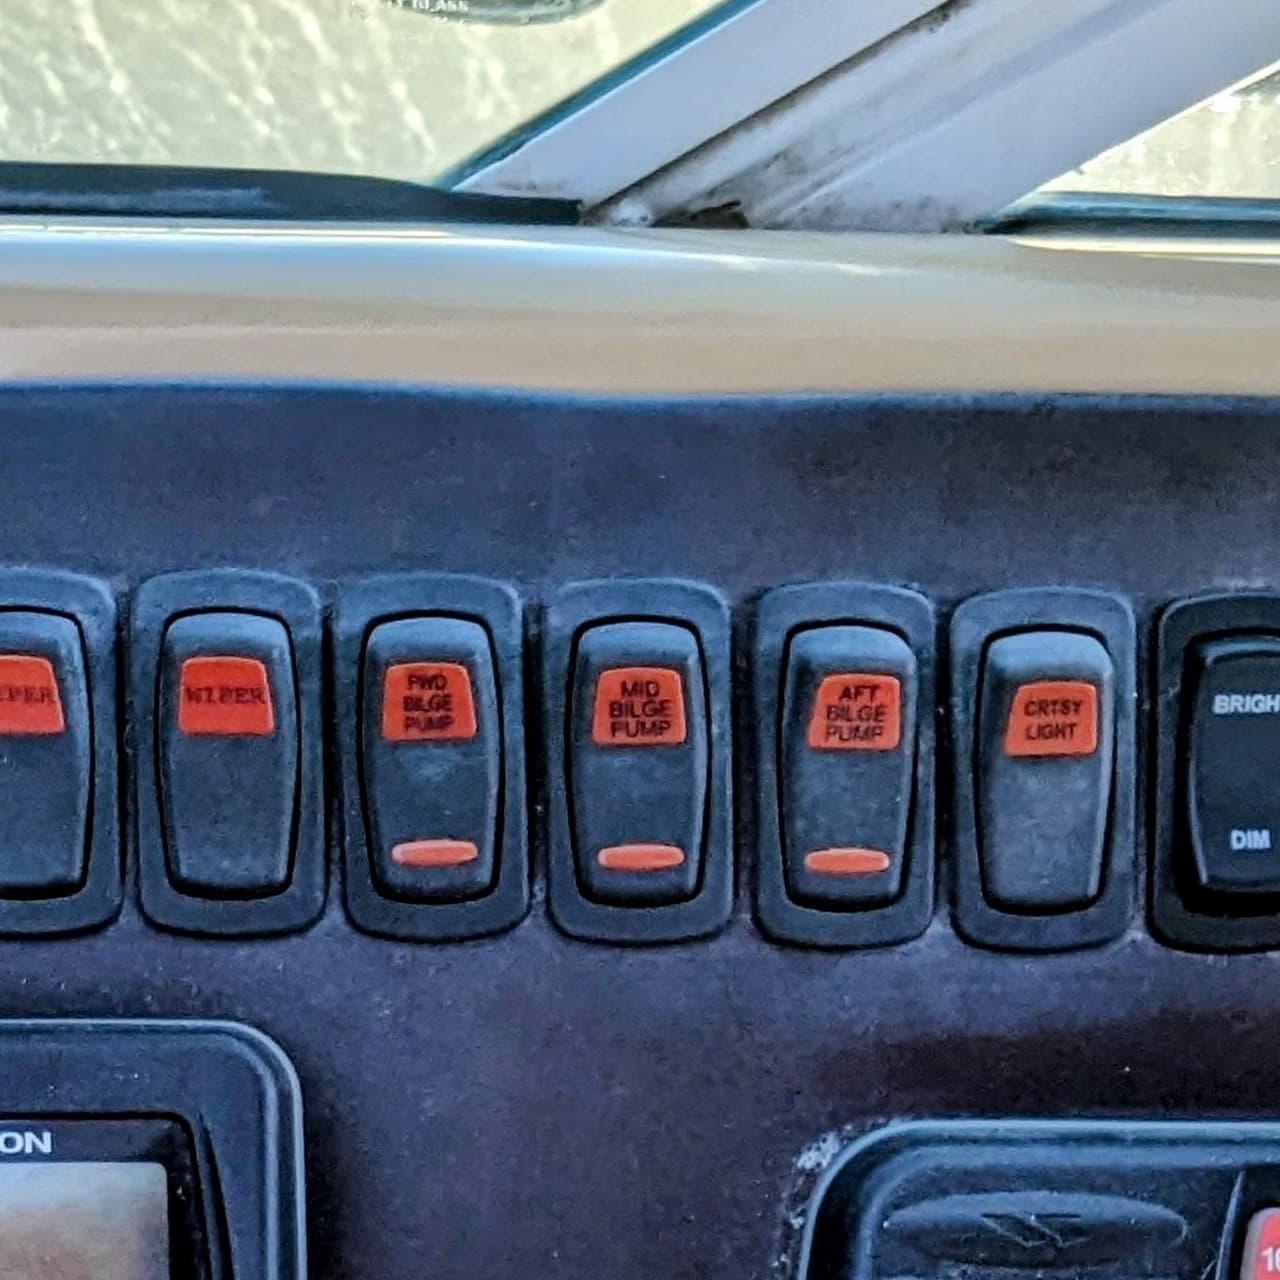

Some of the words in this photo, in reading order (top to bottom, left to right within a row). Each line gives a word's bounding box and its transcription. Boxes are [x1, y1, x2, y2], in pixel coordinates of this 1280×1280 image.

[407, 673, 447, 691] FWD
[622, 679, 661, 697] MID
[185, 686, 266, 706] WIPER
[838, 684, 879, 701] AFT
[403, 695, 451, 713] BILGE
[610, 700, 671, 718] BILGE
[826, 704, 888, 722] BILGE
[1024, 699, 1081, 717] CRTSY
[404, 714, 454, 732] PUMP
[611, 719, 670, 738] PUMP
[1025, 723, 1076, 741] LIGHT
[826, 724, 883, 742] PUMP
[1230, 829, 1271, 850] DIM
